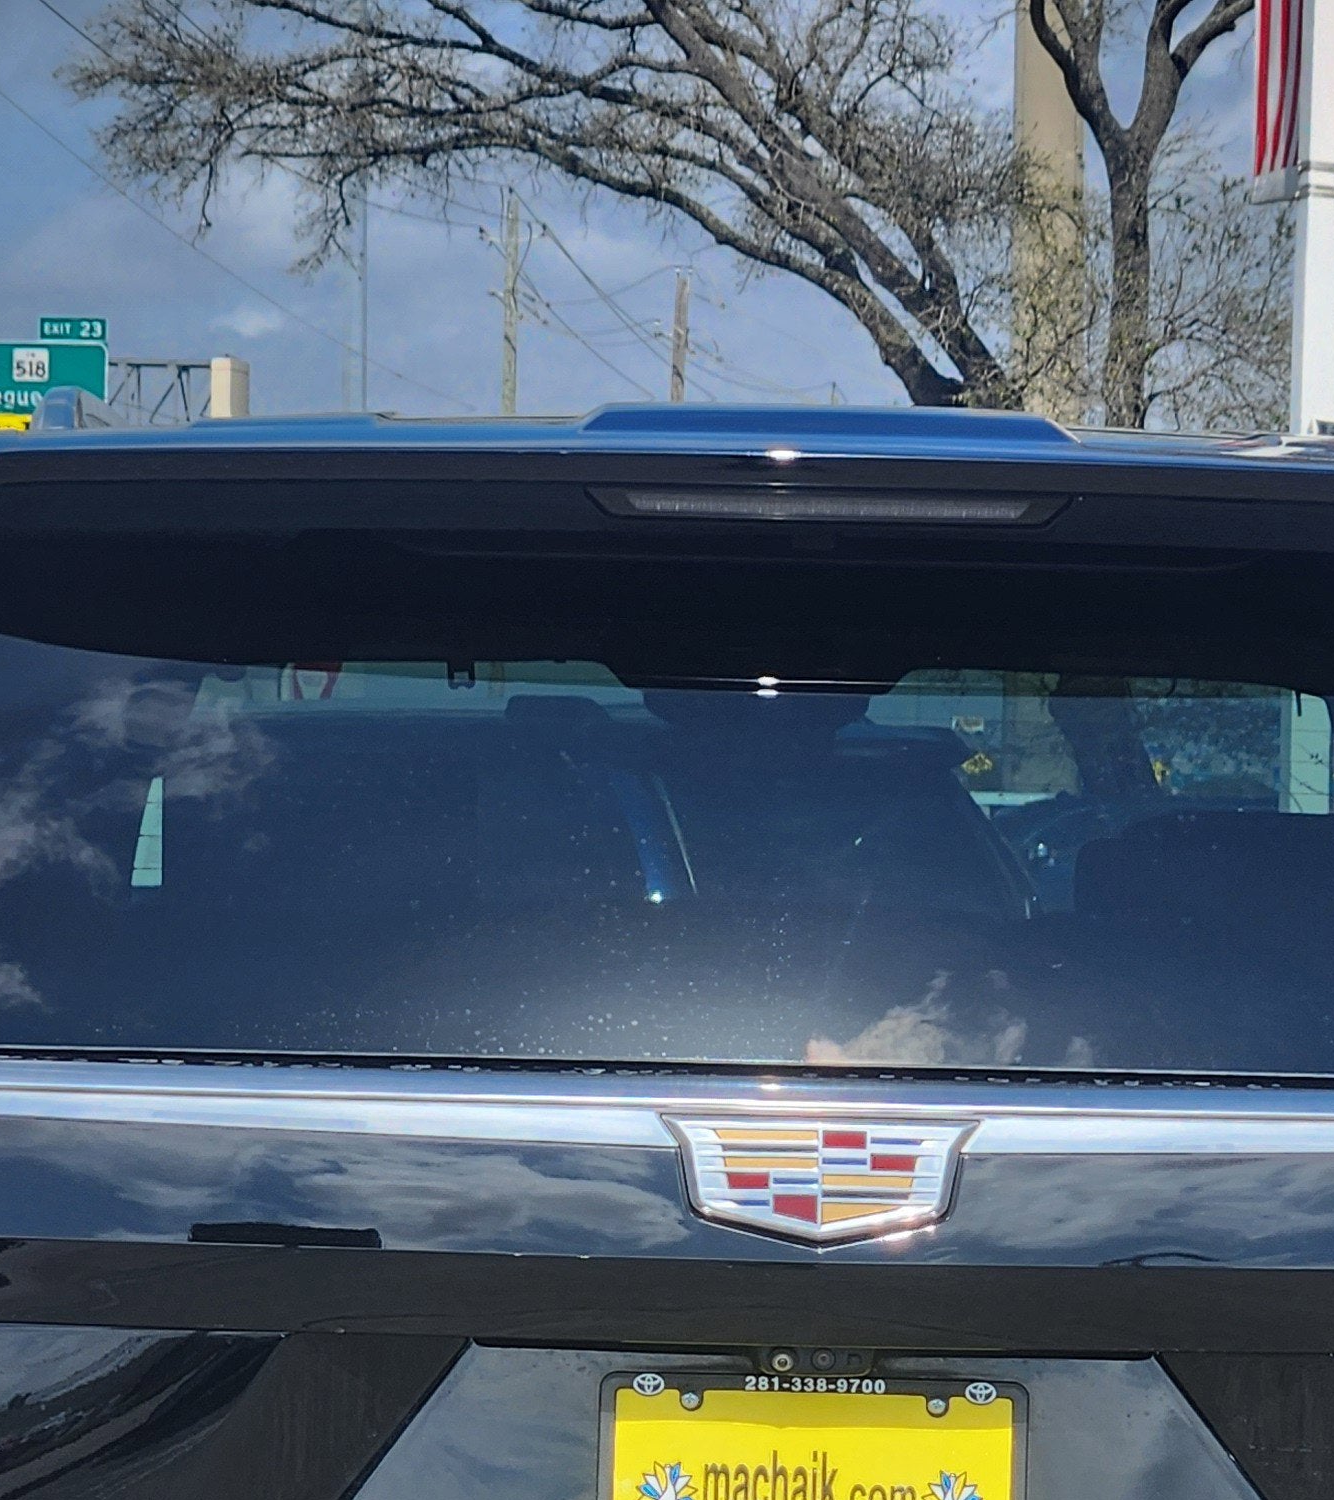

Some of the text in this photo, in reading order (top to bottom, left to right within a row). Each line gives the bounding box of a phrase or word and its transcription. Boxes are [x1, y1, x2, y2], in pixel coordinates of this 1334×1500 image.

[43, 321, 102, 338] EXIT 23
[15, 360, 46, 377] 518
[745, 1376, 886, 1394] 281-338-9700
